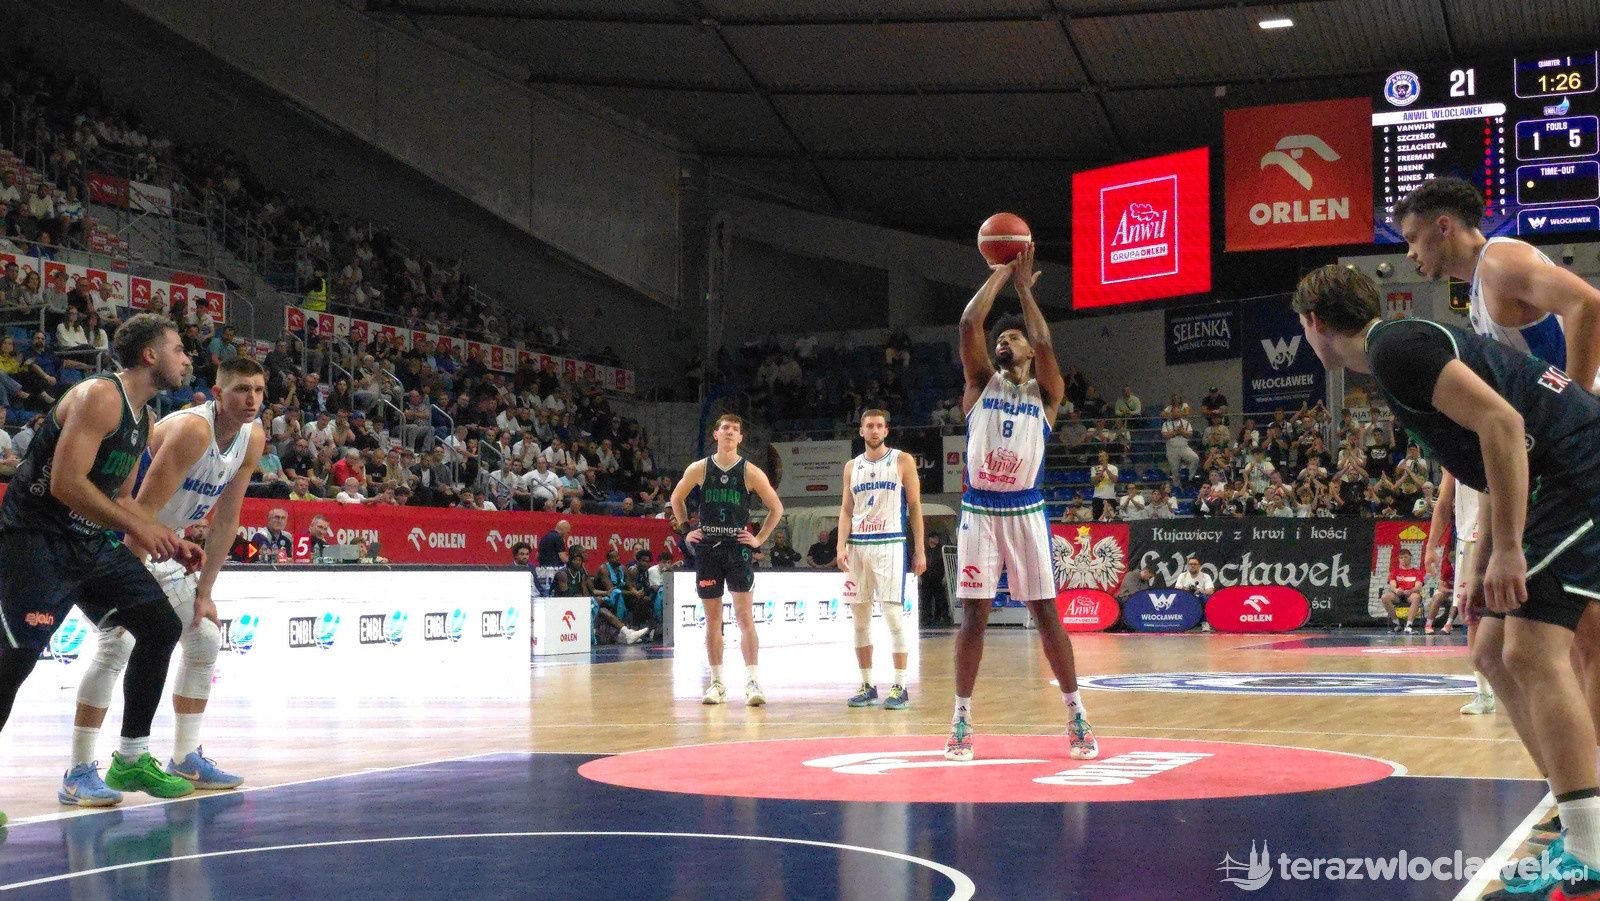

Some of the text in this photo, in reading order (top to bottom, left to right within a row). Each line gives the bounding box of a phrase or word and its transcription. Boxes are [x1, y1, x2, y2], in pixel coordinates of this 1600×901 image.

[1538, 56, 1571, 68] QUARTER 1
[1450, 69, 1475, 97] 21
[1538, 72, 1581, 91] 1:26
[1403, 112, 1428, 121] ANWIL
[1397, 123, 1435, 132] VANWIJN
[1546, 122, 1567, 131] FOULS
[1533, 129, 1581, 150] 1 5
[1397, 153, 1435, 162] FREEMAN
[1397, 164, 1424, 172] BRENK
[1540, 166, 1575, 176] TIME-OUT
[1398, 174, 1422, 182] HINES
[1249, 197, 1350, 226] ORLEN
[1111, 209, 1168, 247] Anwil
[1550, 216, 1591, 225] WŁOCŁAWEK
[1173, 318, 1232, 345] SELENKA
[1252, 374, 1314, 390] WŁOCŁAWEK
[1002, 420, 1014, 439] 8
[982, 450, 1024, 475] Anwil
[705, 489, 741, 506] DONAR
[867, 495, 875, 506] 4
[189, 504, 209, 520] 16
[719, 508, 726, 522] 5
[428, 532, 466, 549] ORLEN
[1152, 526, 1347, 543] Kujawiacy z krwi i kości
[296, 536, 309, 556] 5
[567, 536, 597, 550] ORLEN
[1064, 598, 1100, 616] Anwil
[1141, 613, 1183, 621] WŁOCŁAWEK
[1240, 614, 1272, 622] ORLEN
[290, 619, 314, 646] ENBL
[361, 616, 384, 643] ENBL
[560, 633, 577, 642] ORLEN
